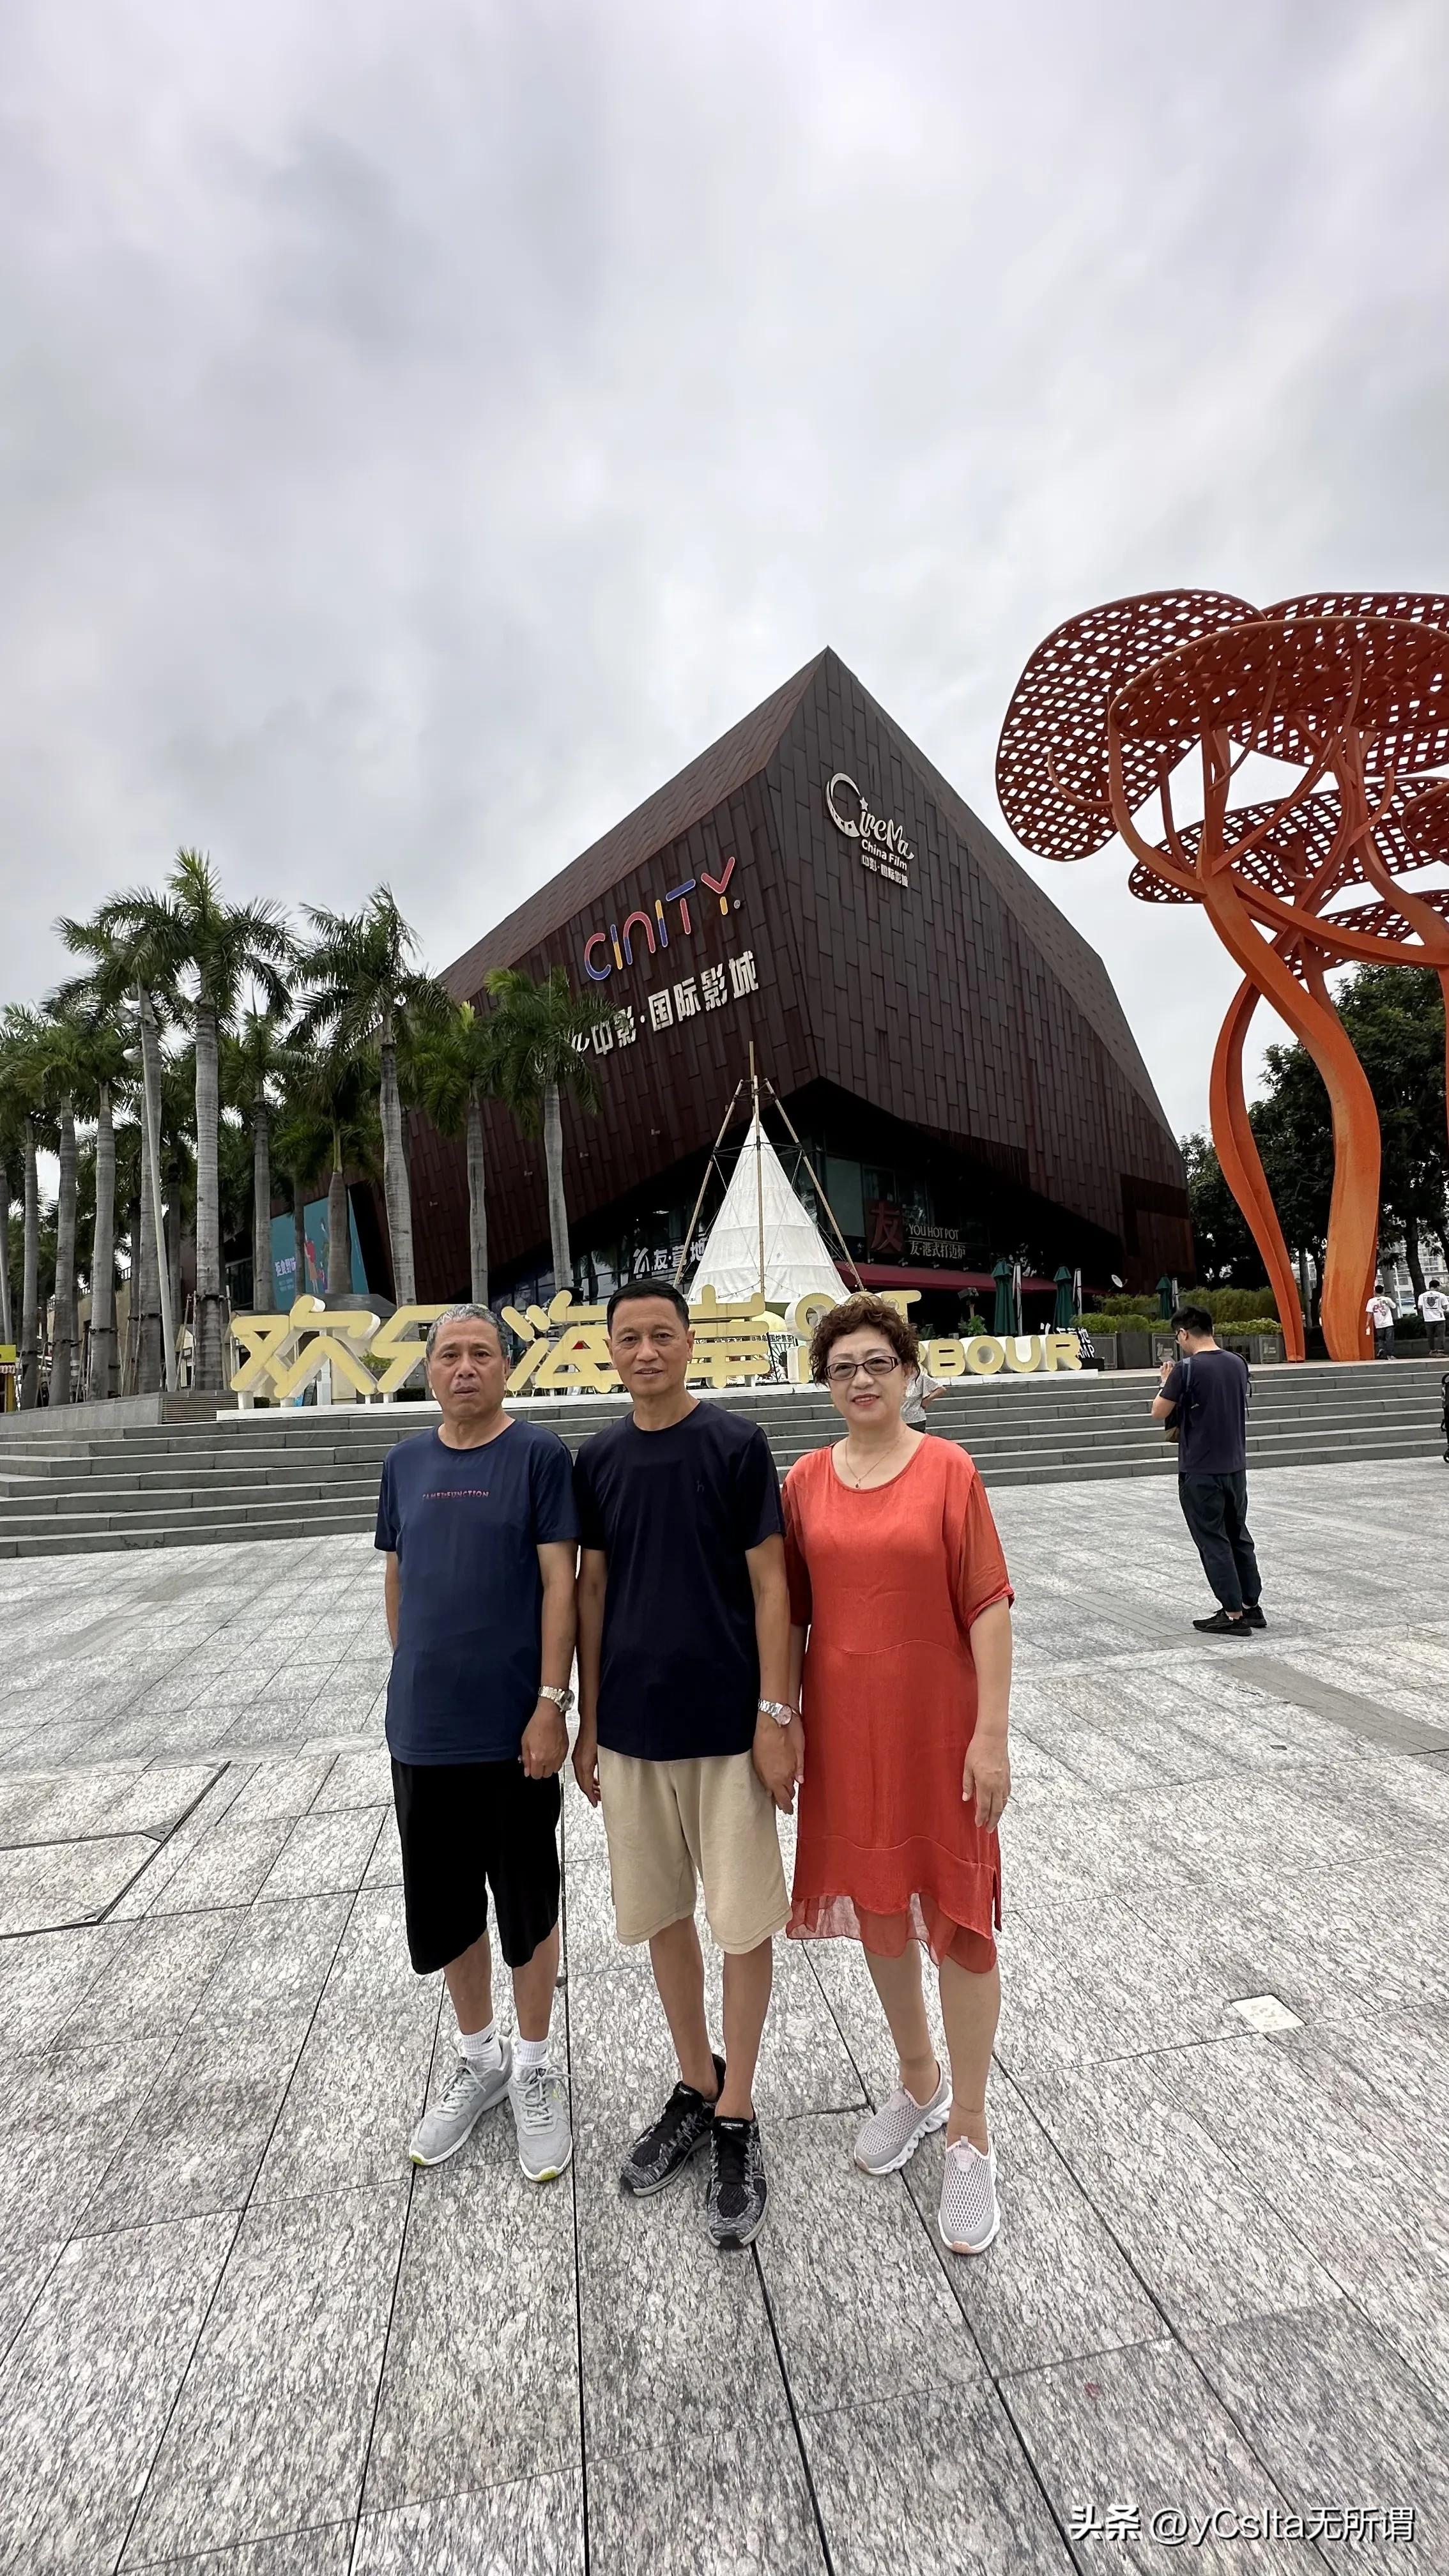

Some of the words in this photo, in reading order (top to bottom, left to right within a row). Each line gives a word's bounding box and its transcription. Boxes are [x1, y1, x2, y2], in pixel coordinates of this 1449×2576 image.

[861, 838, 887, 861] China
[889, 853, 908, 871] Film
[908, 1223, 926, 1236] YOU
[928, 1226, 944, 1239] HOT
[944, 1229, 960, 1241] POT
[791, 1289, 921, 1341] OT
